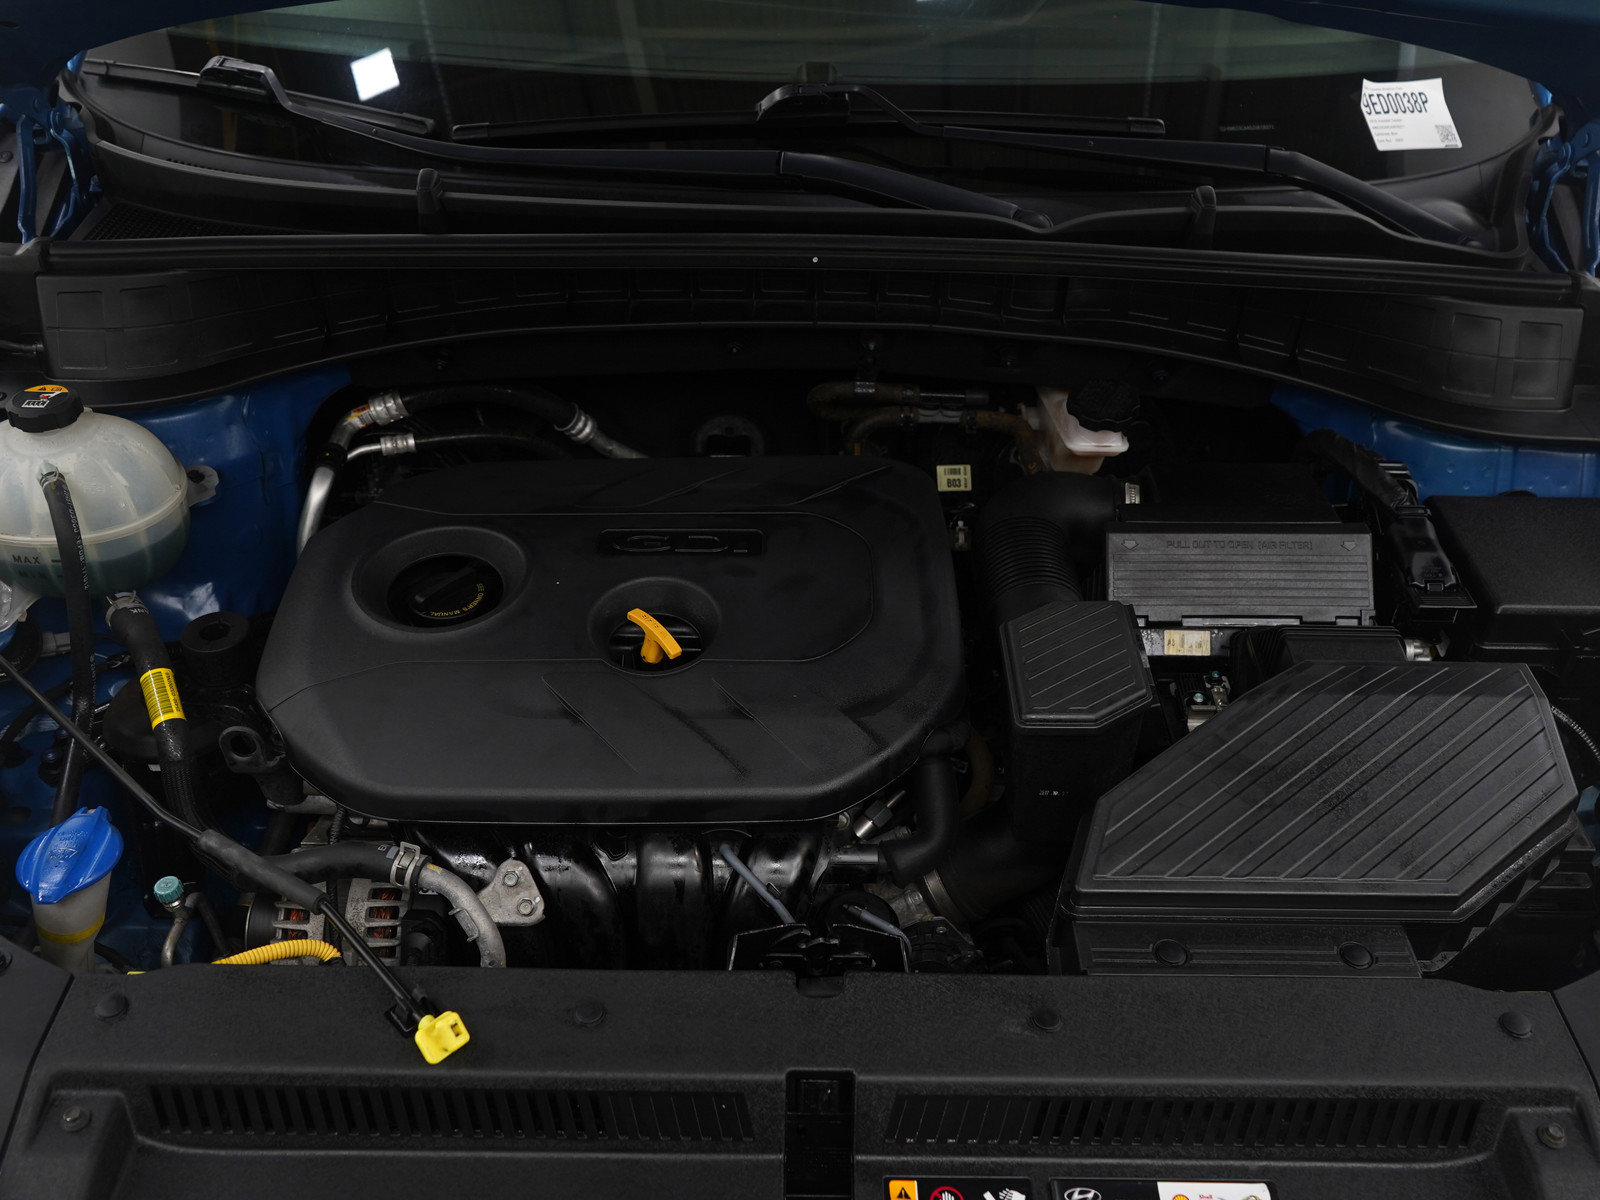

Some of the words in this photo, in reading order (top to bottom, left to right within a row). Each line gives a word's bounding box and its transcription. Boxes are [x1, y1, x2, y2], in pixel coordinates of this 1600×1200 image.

[1362, 91, 1429, 115] 9ED0038P
[1166, 540, 1191, 549] PULL
[1192, 540, 1211, 549] OUT
[1214, 540, 1226, 549] TO
[1279, 541, 1313, 550] FILTER)
[12, 554, 40, 565] MAX
